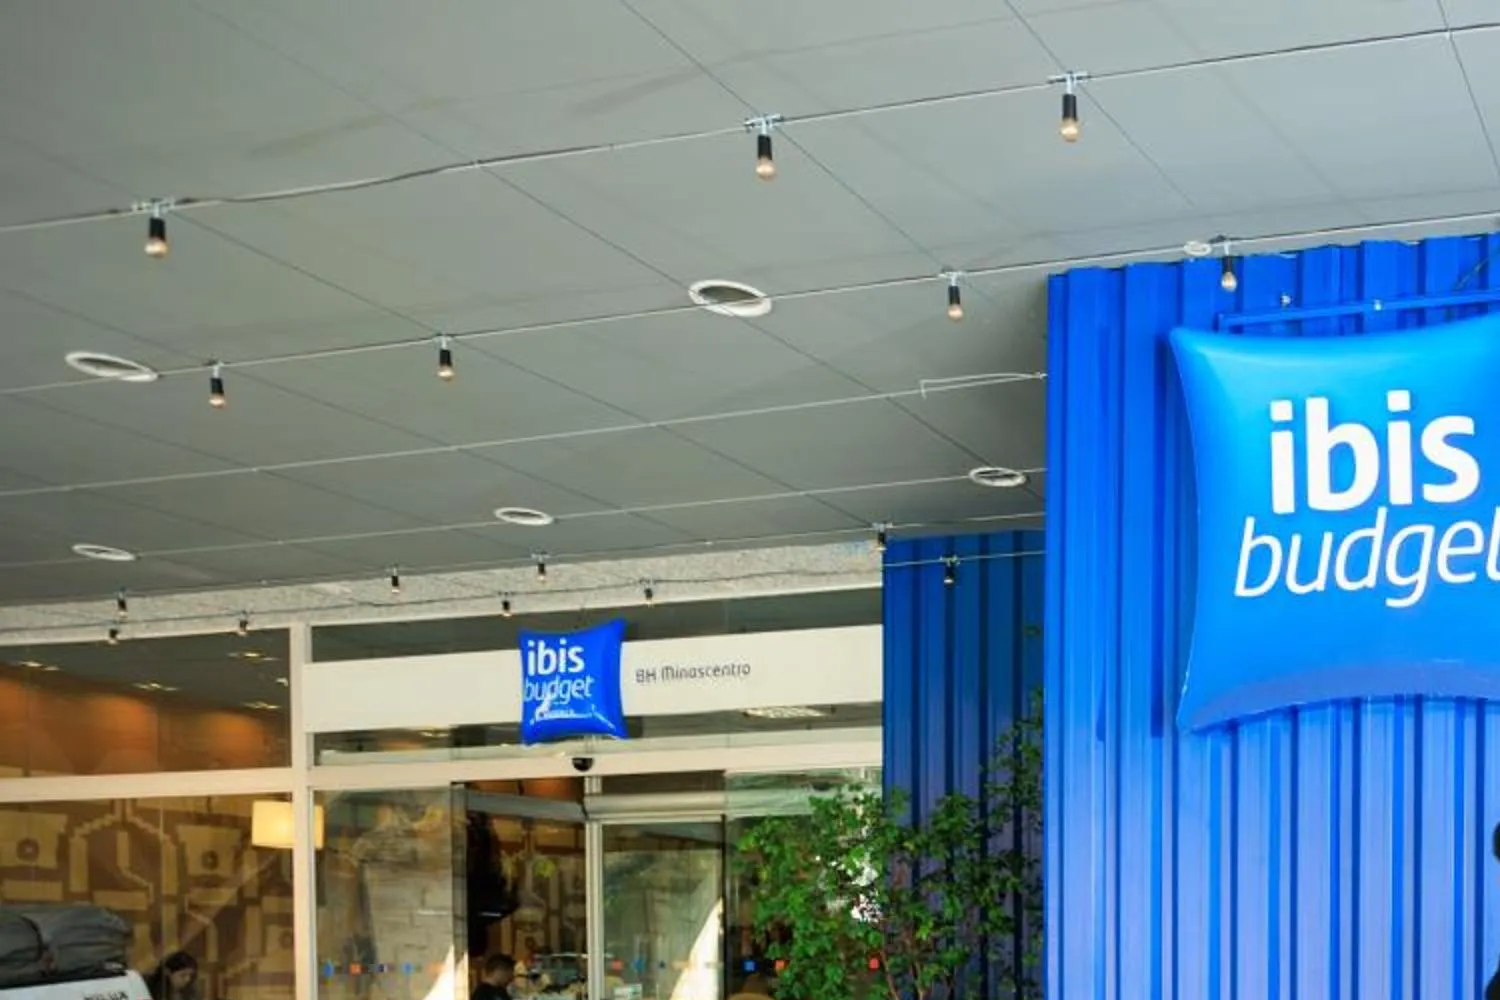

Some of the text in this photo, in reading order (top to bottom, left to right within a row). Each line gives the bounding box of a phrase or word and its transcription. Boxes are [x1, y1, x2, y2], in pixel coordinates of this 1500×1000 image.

[1270, 390, 1480, 514] ibis
[527, 638, 585, 676] ibis
[635, 663, 751, 683] BH Minascentro
[524, 674, 595, 704] budget
